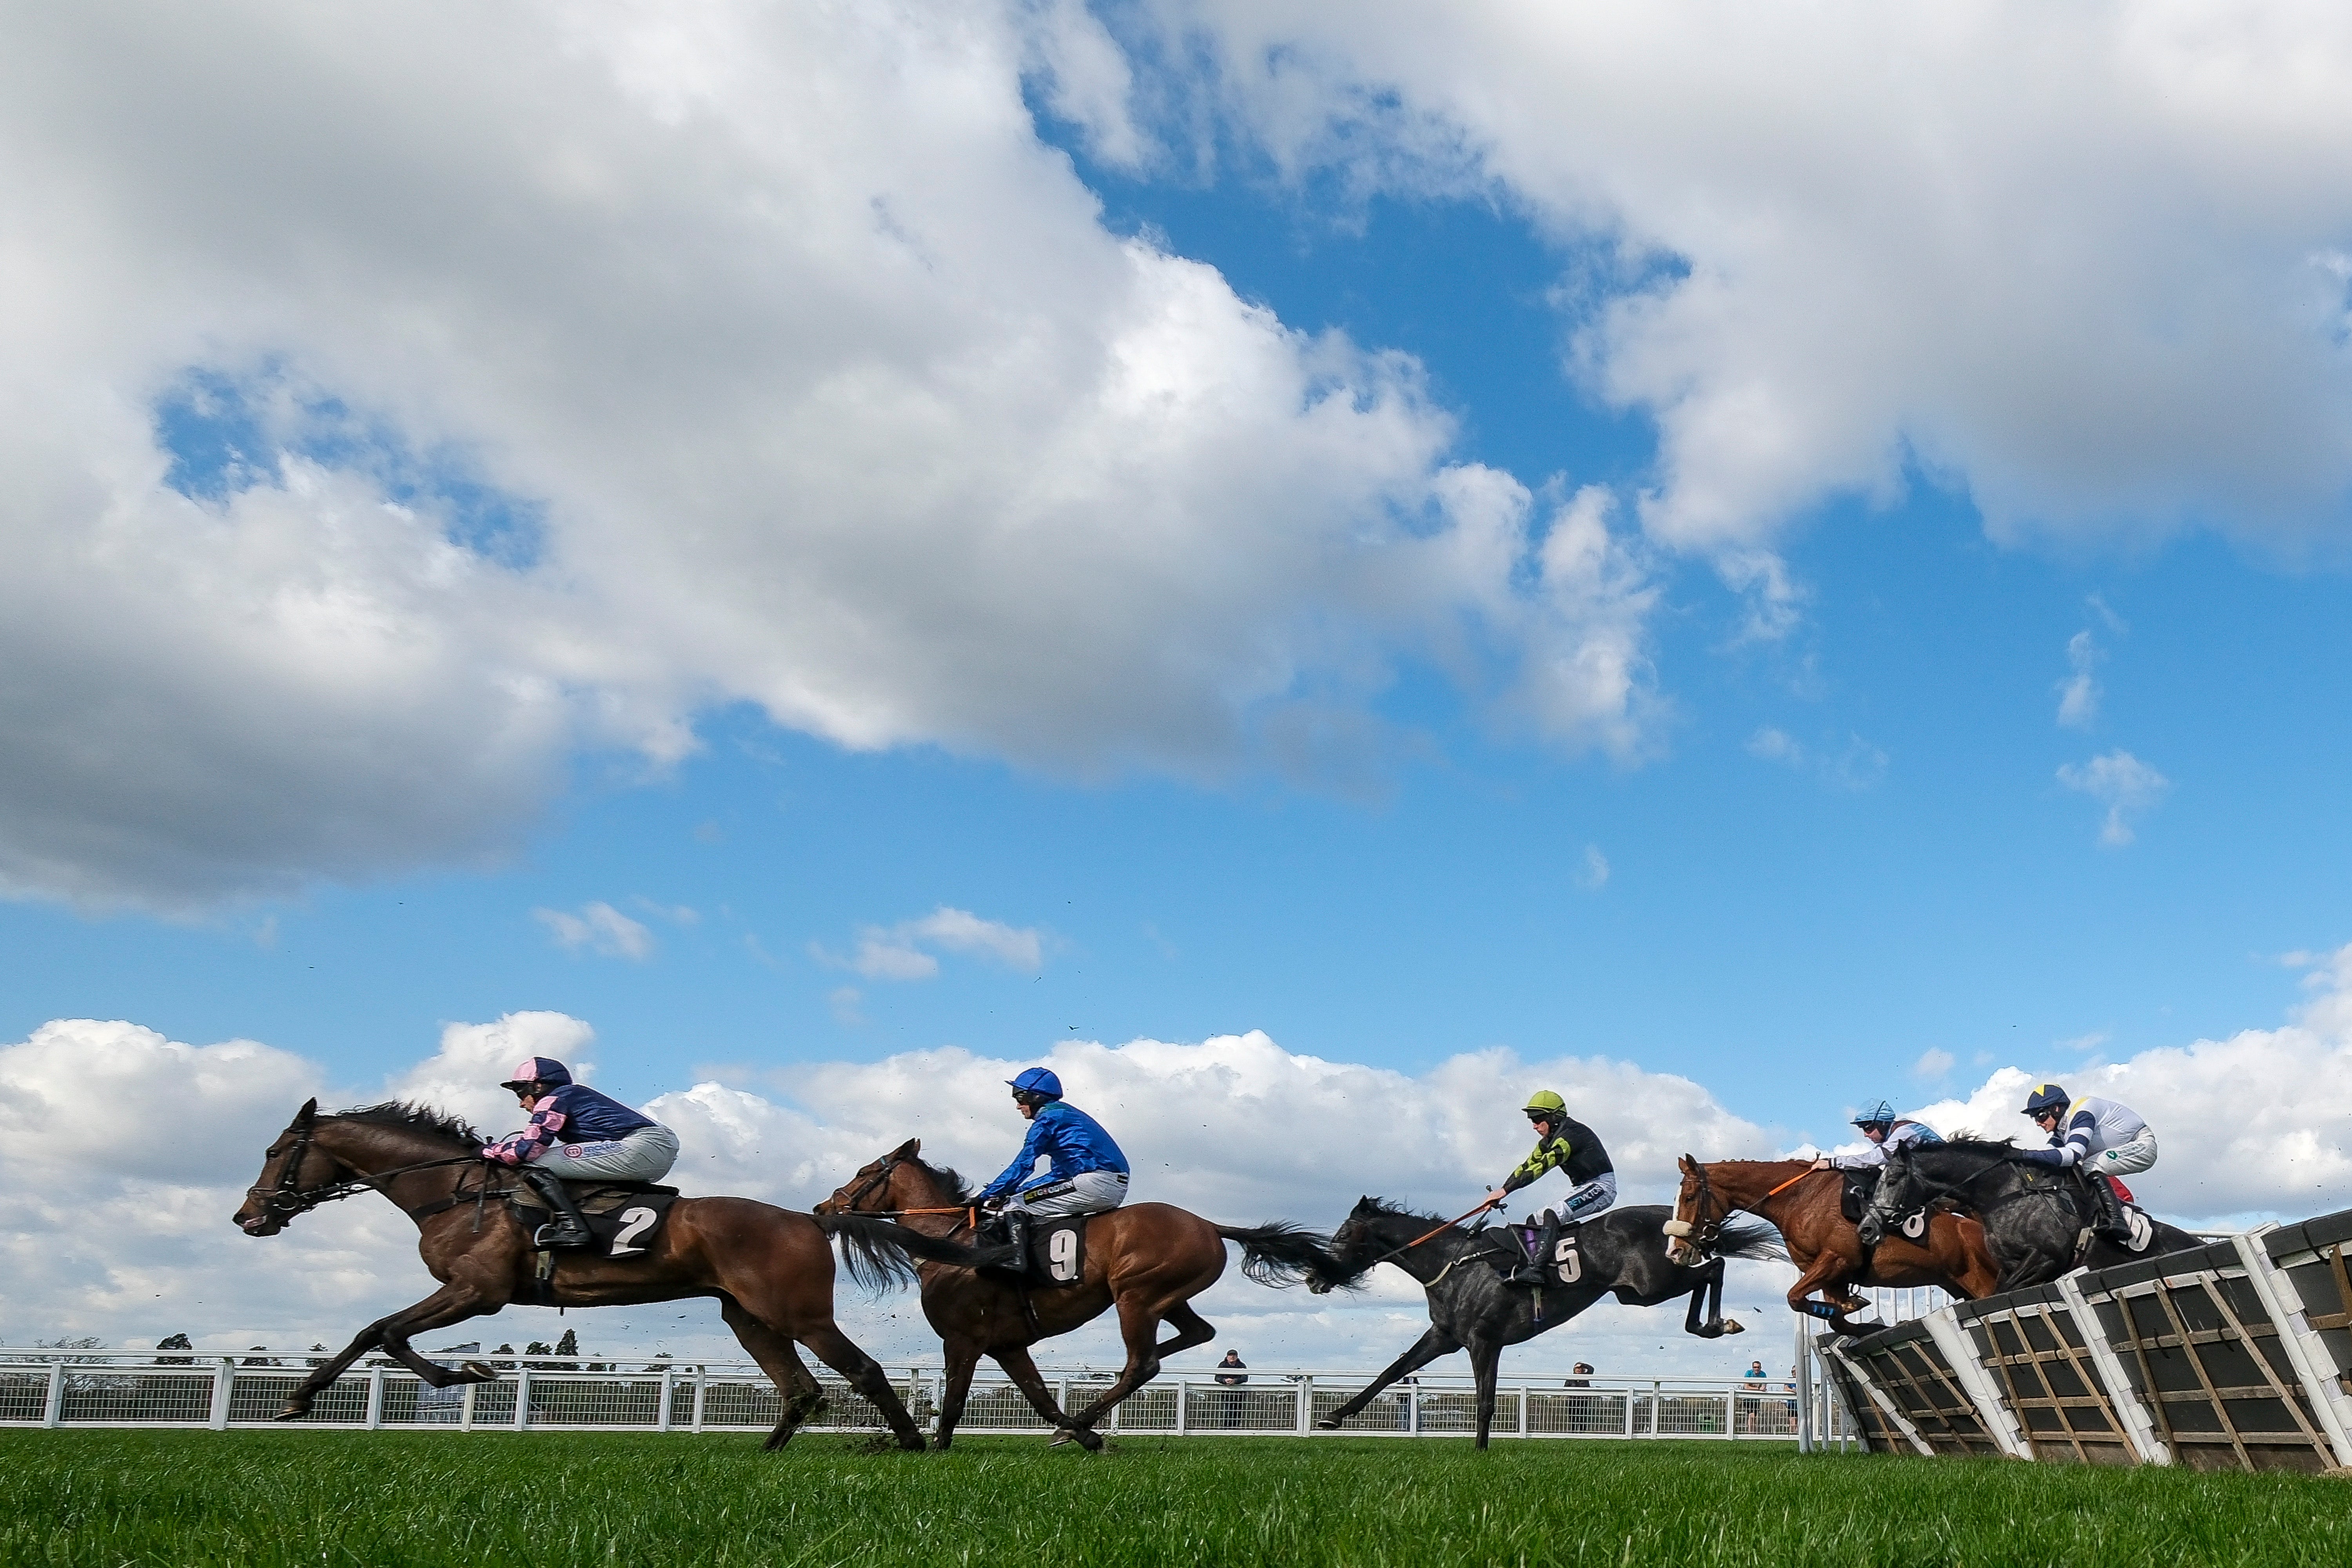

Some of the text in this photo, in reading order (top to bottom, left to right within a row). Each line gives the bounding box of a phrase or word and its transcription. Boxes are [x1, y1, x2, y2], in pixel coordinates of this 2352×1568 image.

[610, 1207, 657, 1256] 2
[1050, 1229, 1077, 1280] 9
[1555, 1237, 1582, 1282] 5
